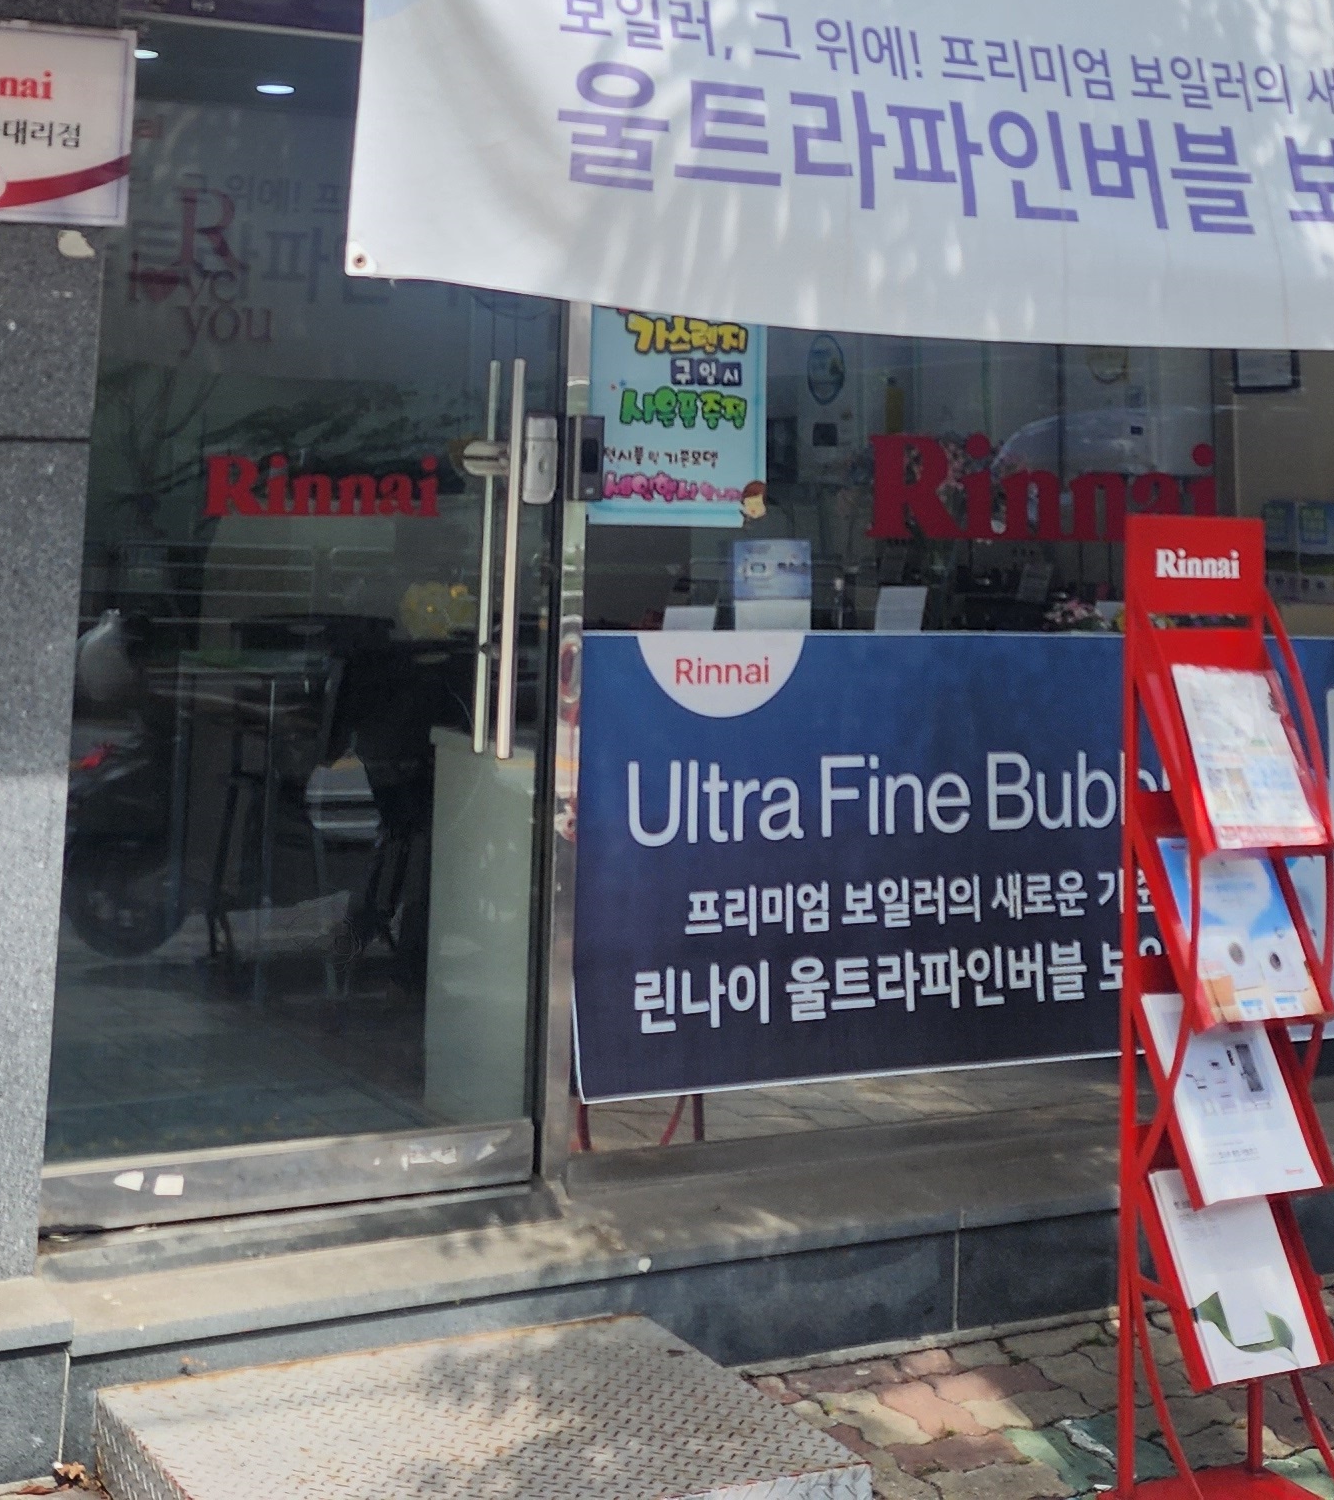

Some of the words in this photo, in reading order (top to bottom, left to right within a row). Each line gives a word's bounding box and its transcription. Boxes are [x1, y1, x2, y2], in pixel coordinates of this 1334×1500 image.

[755, 12, 801, 60] 그
[815, 19, 923, 80] 위에!
[941, 36, 1115, 100] 프리미엄
[1130, 55, 1293, 113] 보일러의
[557, 61, 1255, 235] 울트라파인버블
[203, 454, 440, 517] Rinnai
[1155, 547, 1241, 580] Rinnai
[674, 656, 770, 686] Rinnai
[627, 759, 805, 847] Ultra
[820, 754, 971, 838] Fine
[987, 750, 1171, 831] Bub
[684, 880, 830, 937] 프리미엄
[841, 874, 982, 929] 보일러의
[991, 869, 1088, 921] 새로운
[634, 959, 770, 1034] 린나이
[786, 940, 1087, 1022] 울트라파인버블
